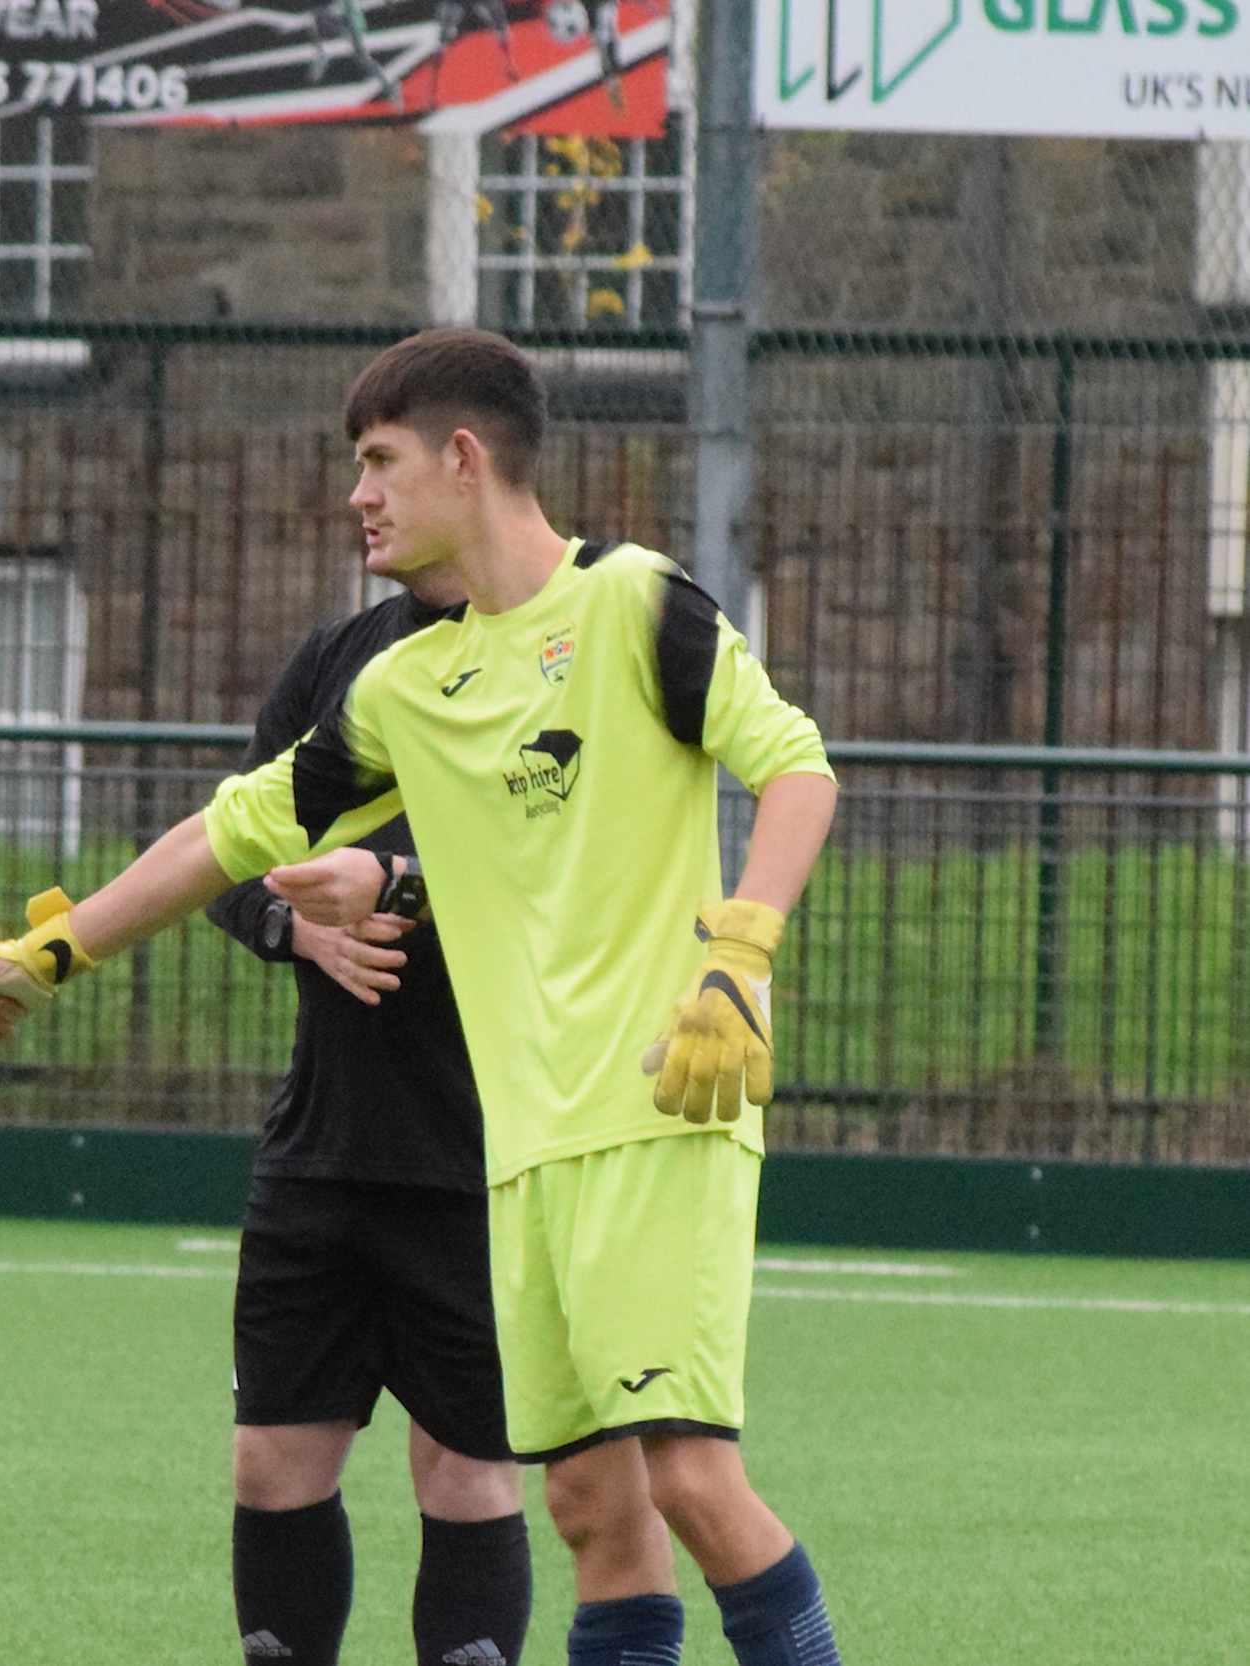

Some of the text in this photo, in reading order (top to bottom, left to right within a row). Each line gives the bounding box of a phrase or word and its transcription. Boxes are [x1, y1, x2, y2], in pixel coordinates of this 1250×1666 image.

[21, 60, 189, 109] 771406
[1123, 72, 1204, 110] UK'S
[526, 763, 561, 790] hire
